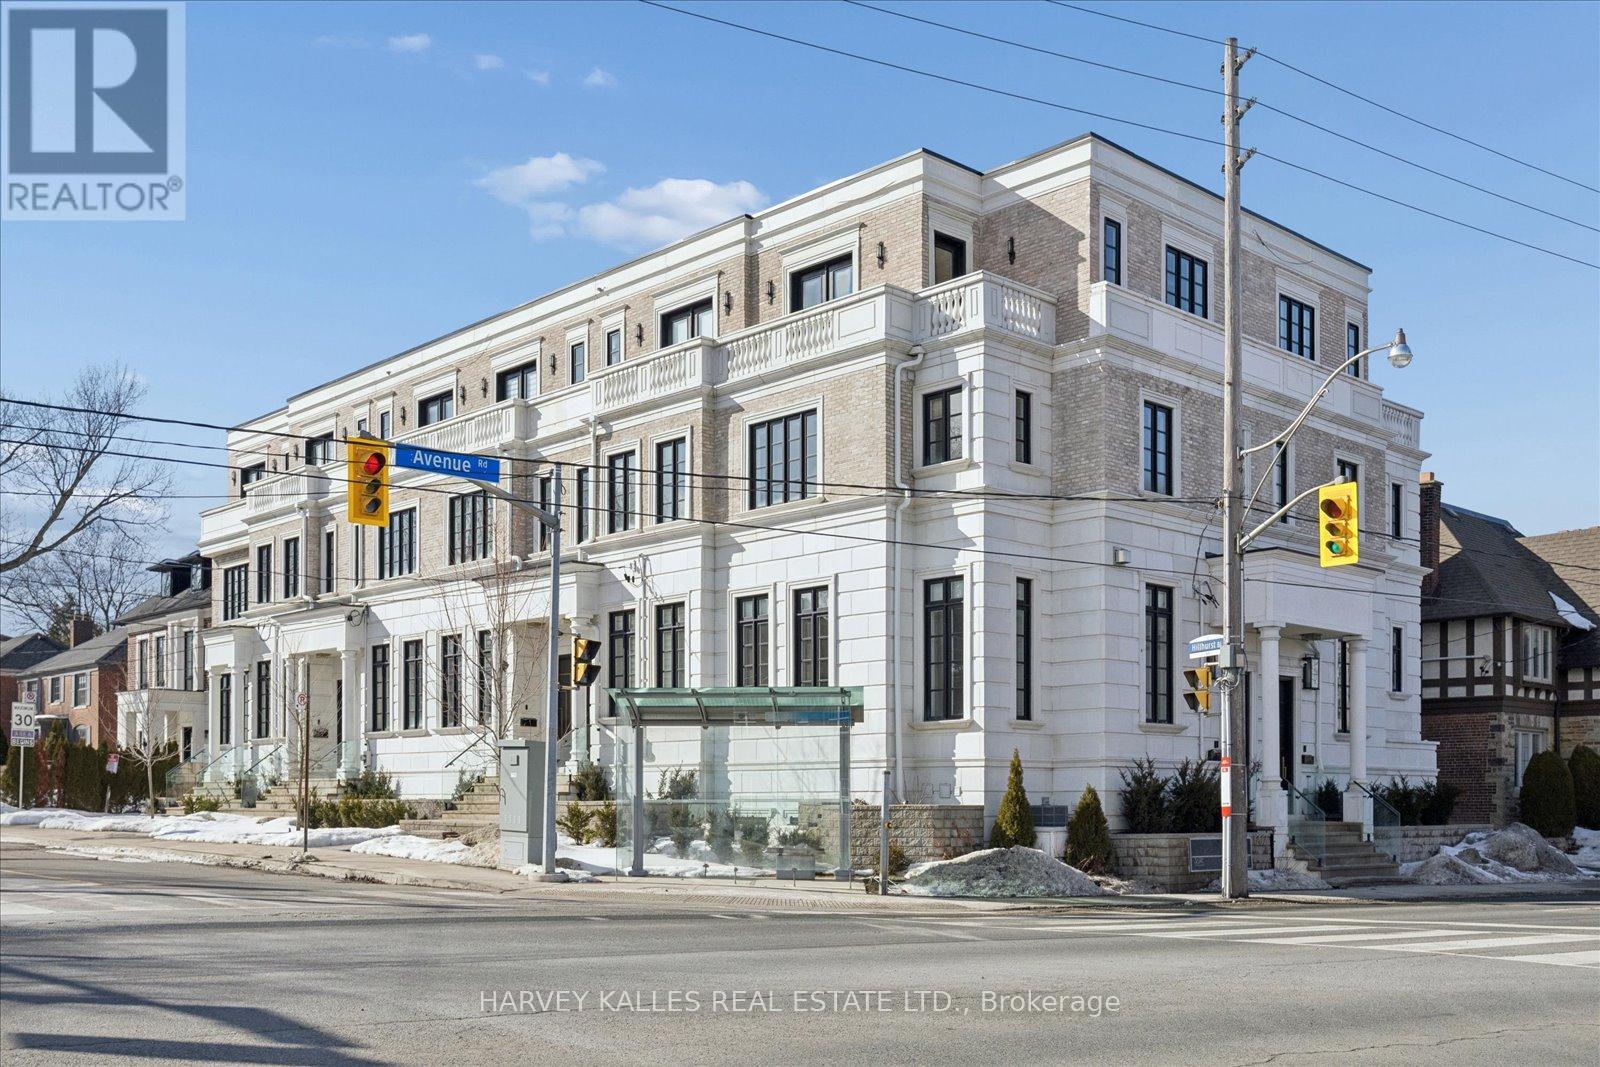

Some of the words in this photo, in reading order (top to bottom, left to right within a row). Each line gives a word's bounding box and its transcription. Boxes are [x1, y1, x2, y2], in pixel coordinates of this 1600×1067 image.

[413, 450, 471, 473] Avenue
[478, 459, 488, 468] Rd
[1191, 641, 1216, 652] Hillhurst
[14, 714, 32, 726] 30
